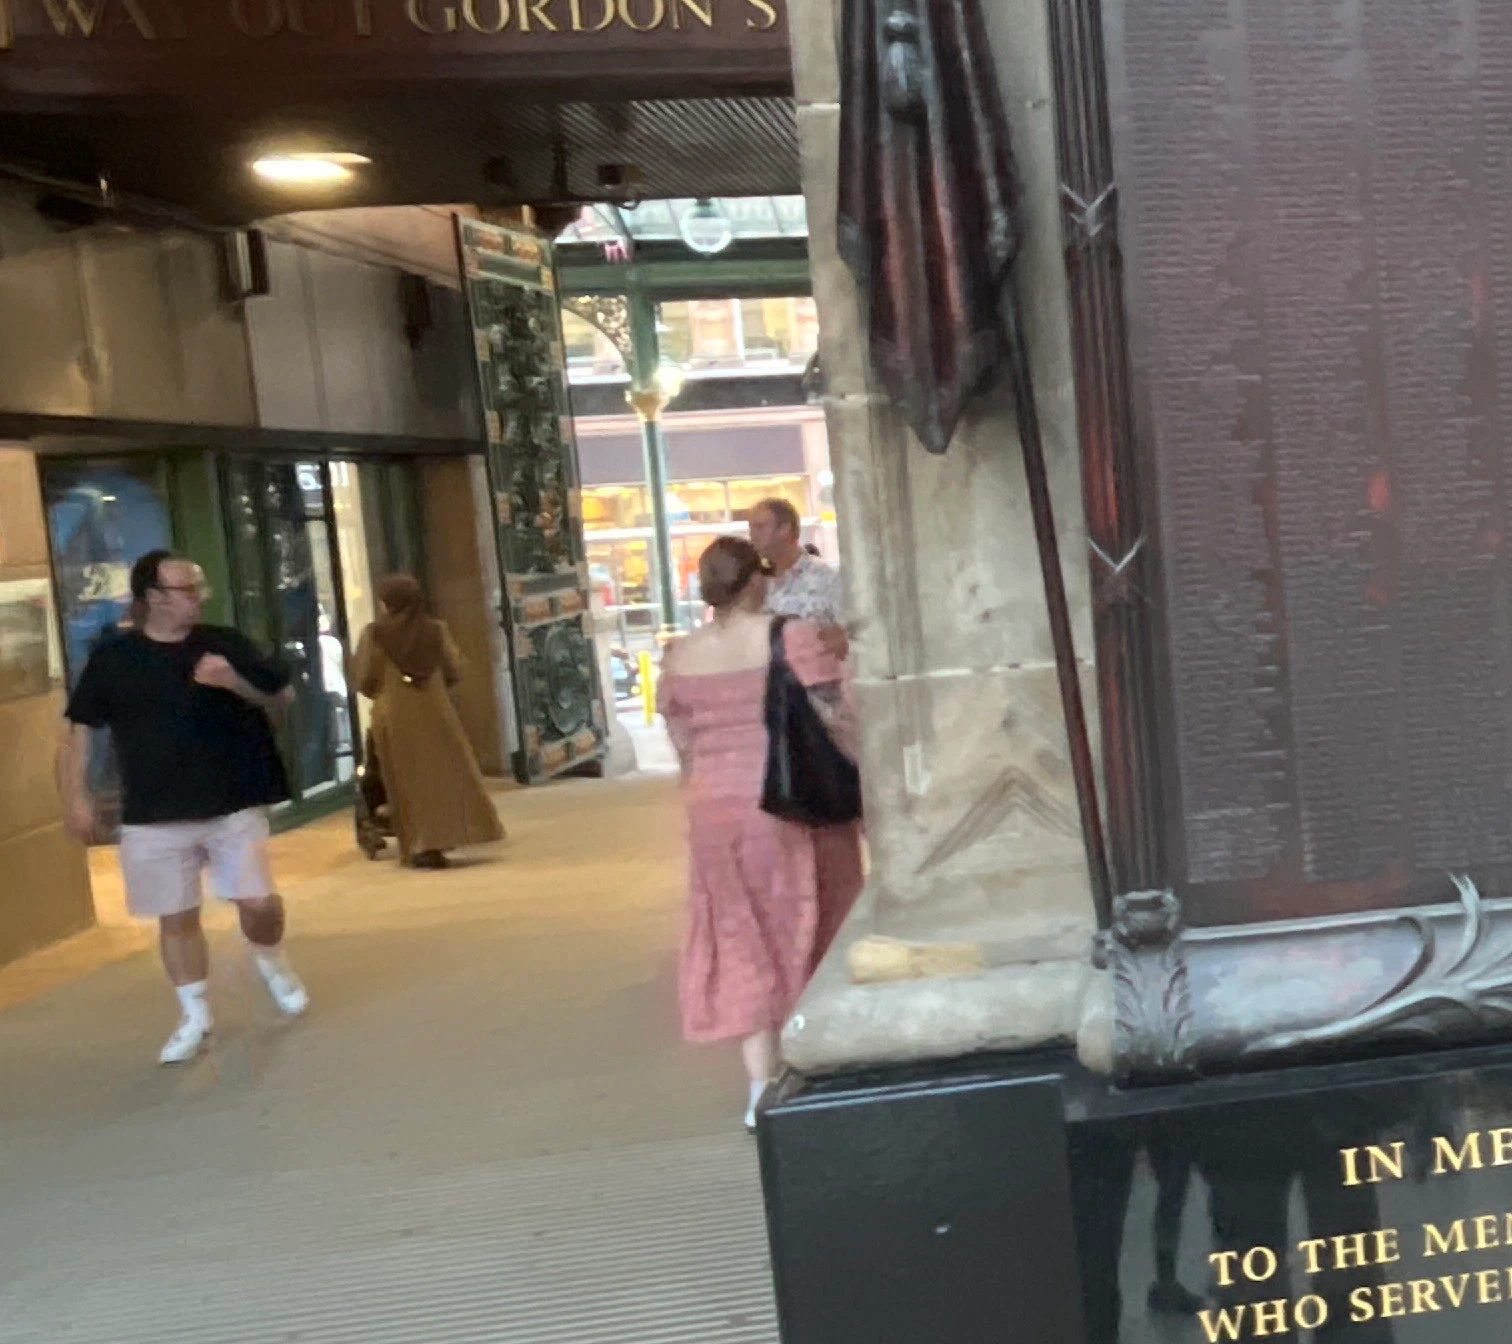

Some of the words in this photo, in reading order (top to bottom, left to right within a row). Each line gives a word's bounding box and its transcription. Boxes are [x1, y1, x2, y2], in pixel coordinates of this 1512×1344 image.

[1340, 1140, 1404, 1186] IN
[1209, 1246, 1277, 1287] TO
[1298, 1228, 1400, 1274] THE
[1197, 1294, 1328, 1344] WHO
